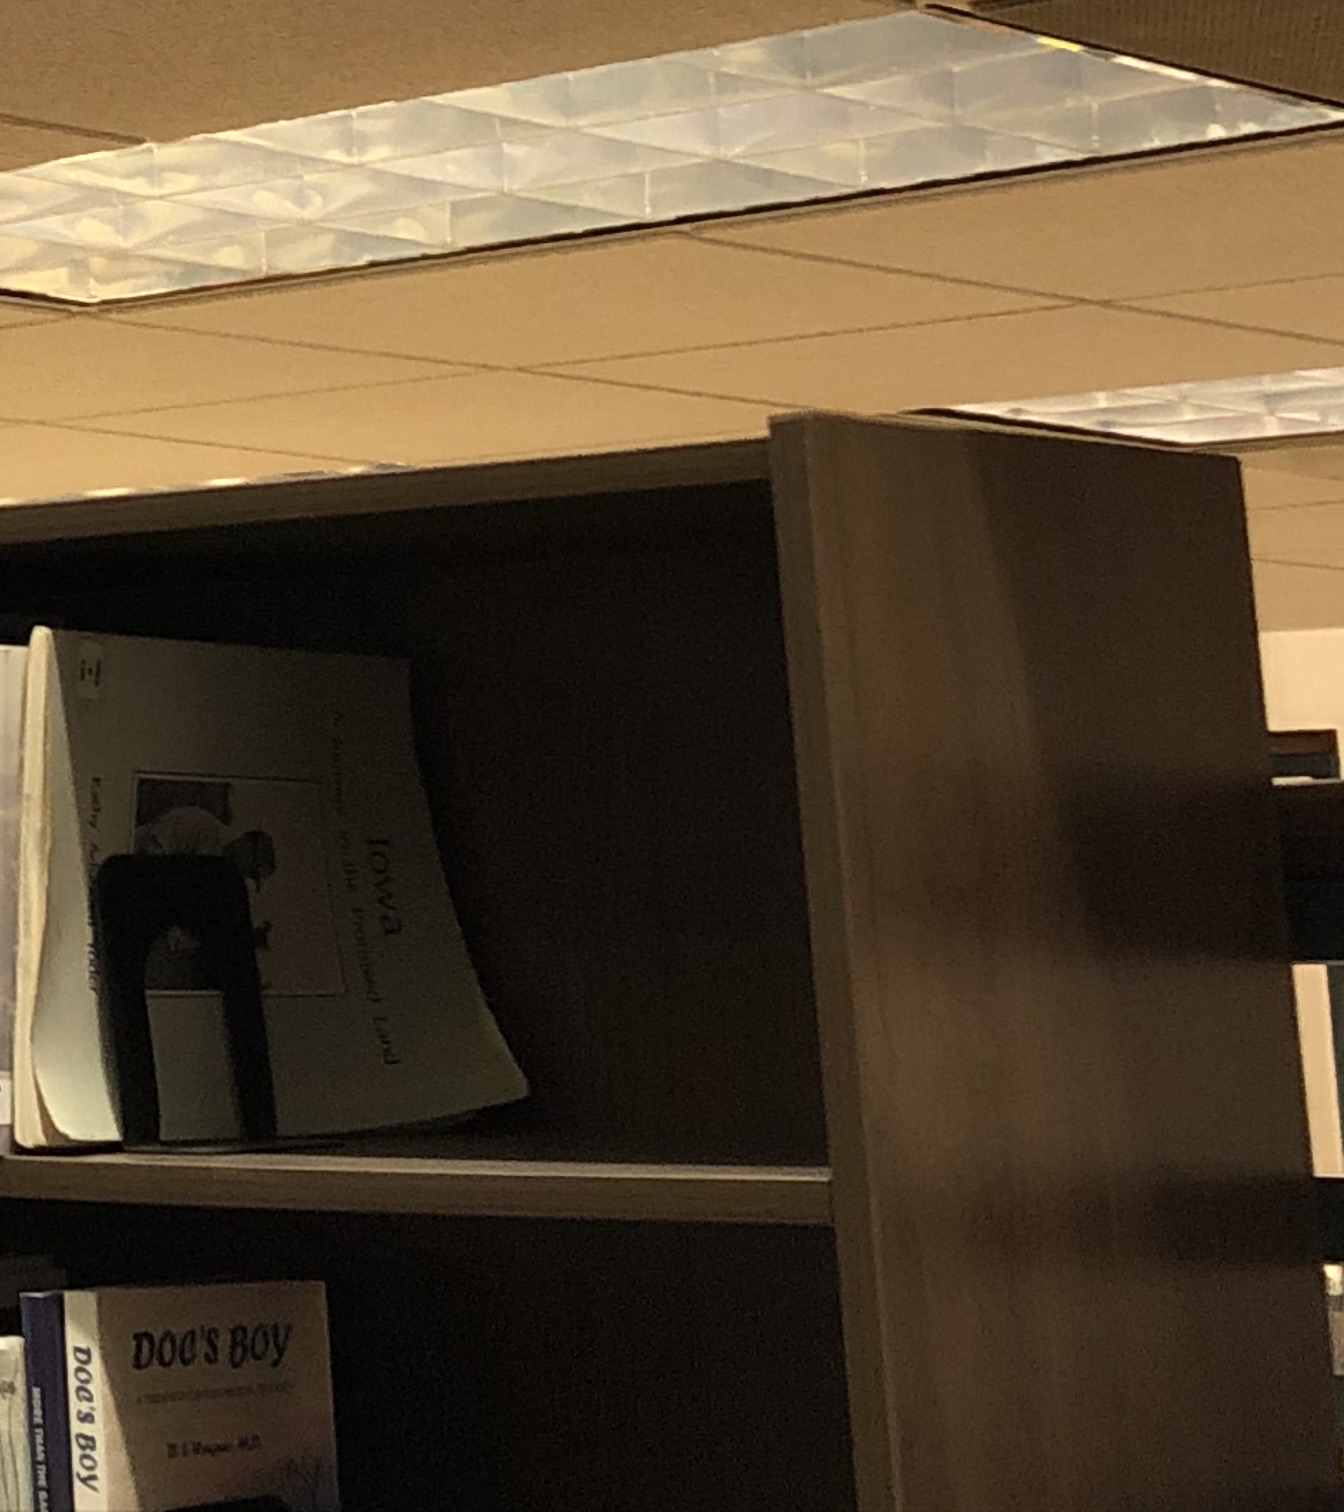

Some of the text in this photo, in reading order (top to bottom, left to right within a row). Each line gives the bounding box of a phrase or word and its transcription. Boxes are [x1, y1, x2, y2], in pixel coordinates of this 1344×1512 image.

[365, 836, 403, 937] Iowa
[369, 1015, 401, 1066] Land
[227, 1321, 294, 1370] BOY
[31, 1385, 44, 1426] MORE
[33, 1427, 46, 1462] THAN
[73, 1430, 100, 1494] BOY
[35, 1463, 47, 1488] THE
